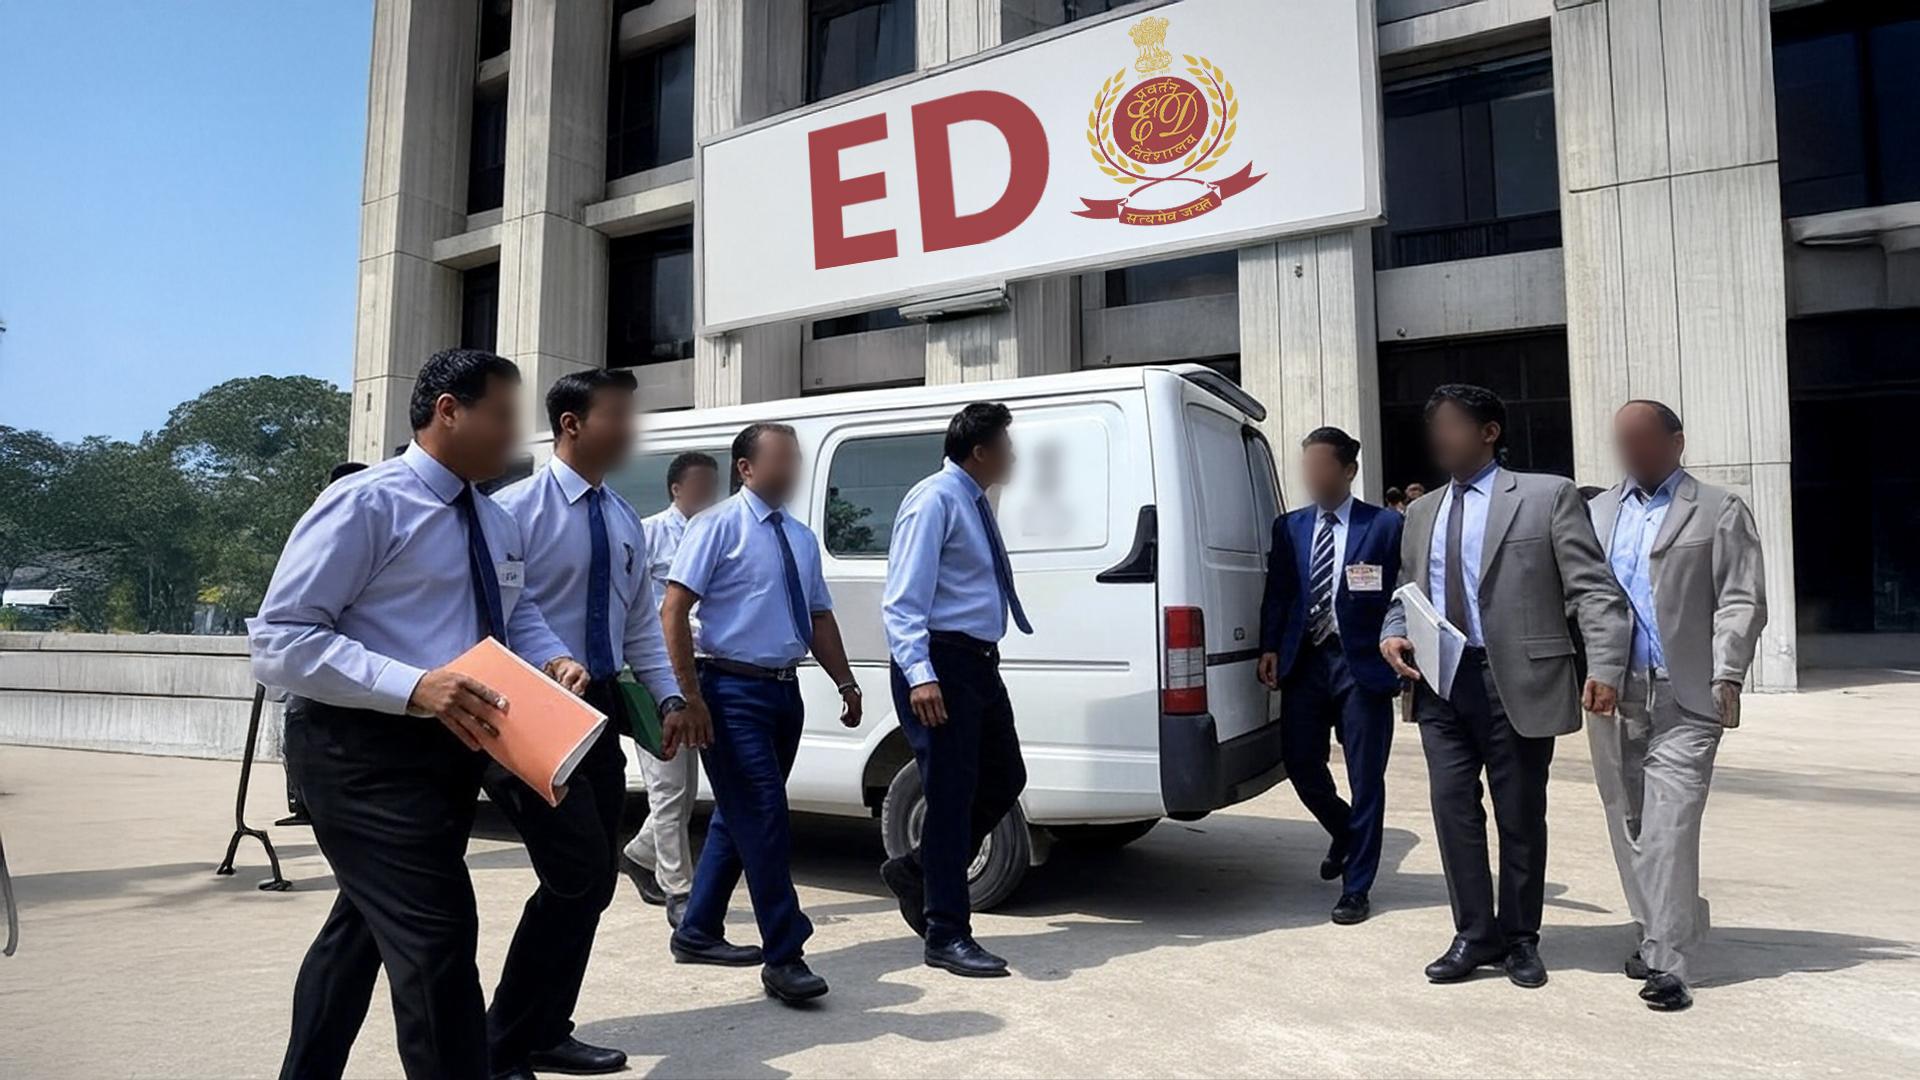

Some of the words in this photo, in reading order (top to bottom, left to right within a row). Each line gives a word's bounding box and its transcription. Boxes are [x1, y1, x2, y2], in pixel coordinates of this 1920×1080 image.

[1134, 78, 1181, 101] प्रवर्तन
[1126, 133, 1198, 161] निदेशालय
[808, 89, 1050, 270] ED
[1126, 210, 1177, 224] सत्यमेव
[1179, 197, 1213, 216] जयते
